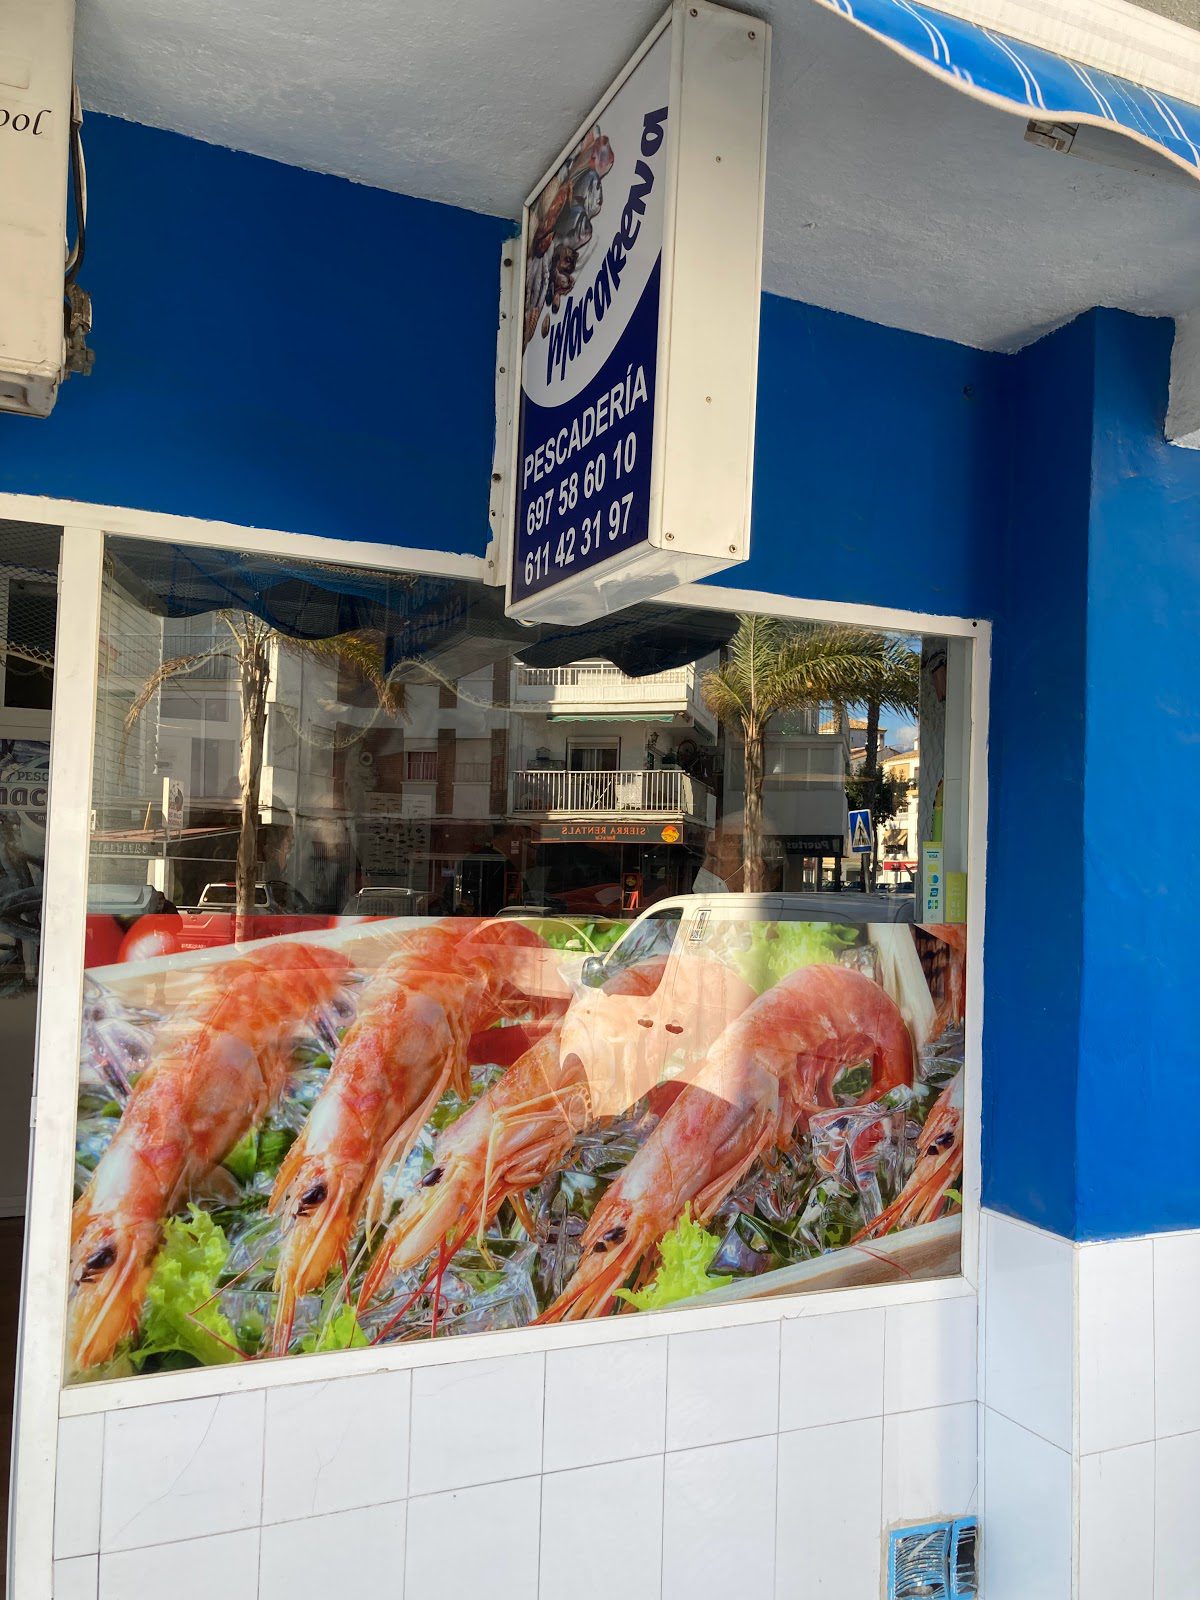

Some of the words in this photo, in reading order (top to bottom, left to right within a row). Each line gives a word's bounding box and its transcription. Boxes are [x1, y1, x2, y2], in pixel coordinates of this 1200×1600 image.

[523, 363, 648, 490] PESCADERÍA
[527, 487, 554, 536] 697
[558, 472, 579, 516] 58
[583, 452, 606, 499] 60
[613, 431, 637, 480] 10
[524, 541, 550, 586] 611
[555, 526, 576, 568] 42
[580, 510, 601, 556] 31
[608, 492, 634, 541] 97
